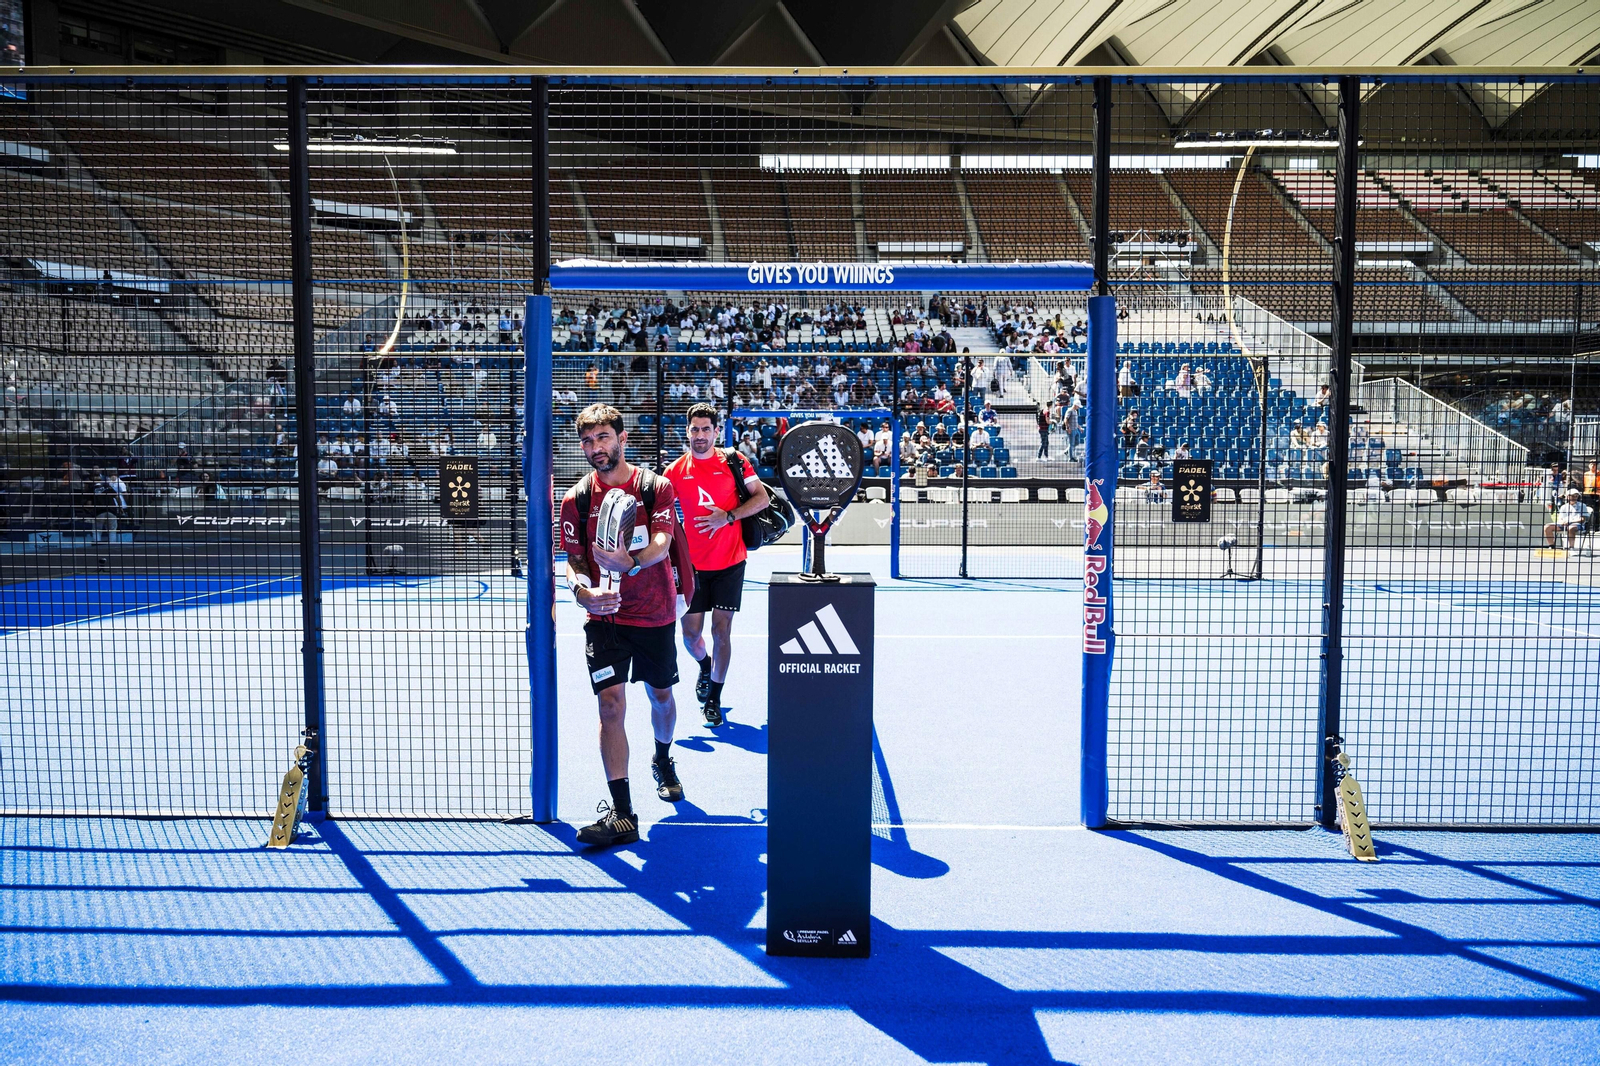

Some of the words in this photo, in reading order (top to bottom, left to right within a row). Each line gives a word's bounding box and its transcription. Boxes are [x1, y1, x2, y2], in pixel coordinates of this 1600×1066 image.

[748, 264, 792, 284] GIVES
[796, 264, 829, 284] YOU
[832, 264, 895, 284] WIIINGS
[193, 516, 287, 526] CUPRA
[1428, 520, 1525, 529] CUPRA
[779, 663, 822, 674] OFFICIAL
[824, 663, 861, 674] RACKET
